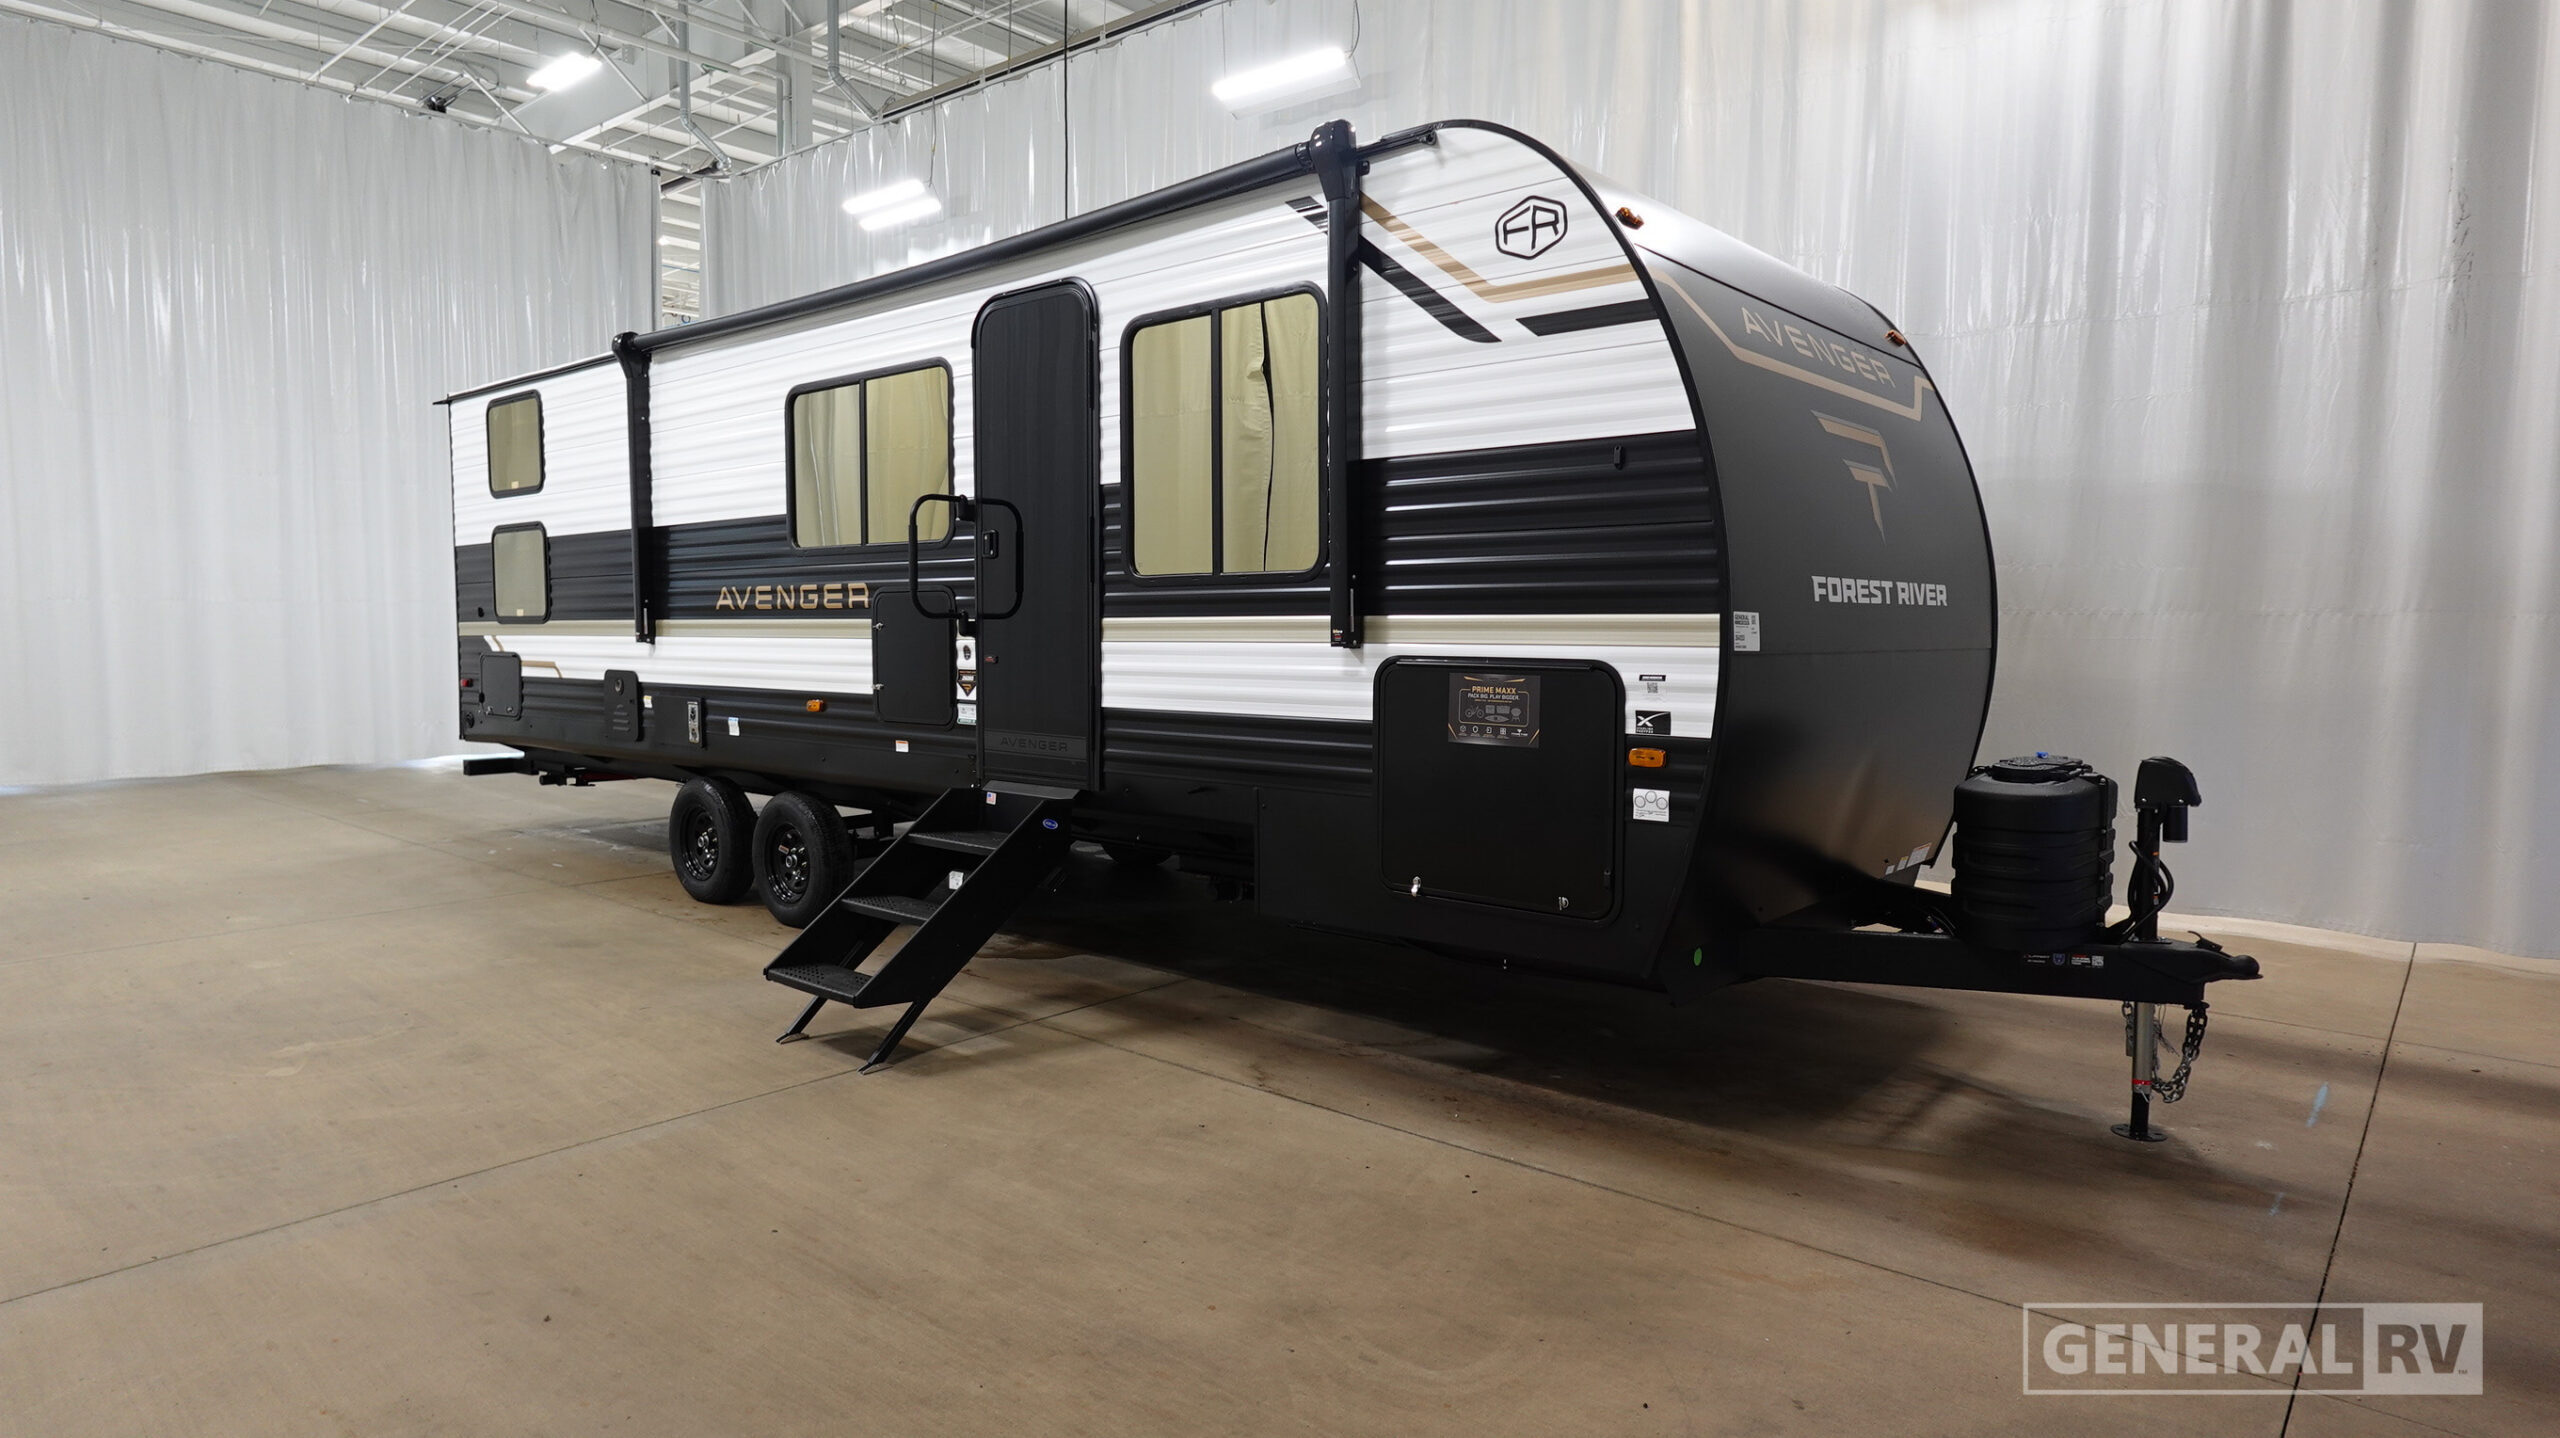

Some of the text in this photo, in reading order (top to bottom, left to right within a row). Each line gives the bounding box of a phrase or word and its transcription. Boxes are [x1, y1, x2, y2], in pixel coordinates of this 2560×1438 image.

[1741, 307, 1896, 388] AVENGER
[715, 582, 870, 610] AVENGER
[1811, 575, 1948, 607] FOREST RIVER
[1472, 686, 1517, 695] PRIME MAXX
[1000, 737, 1068, 752] AVENGER
